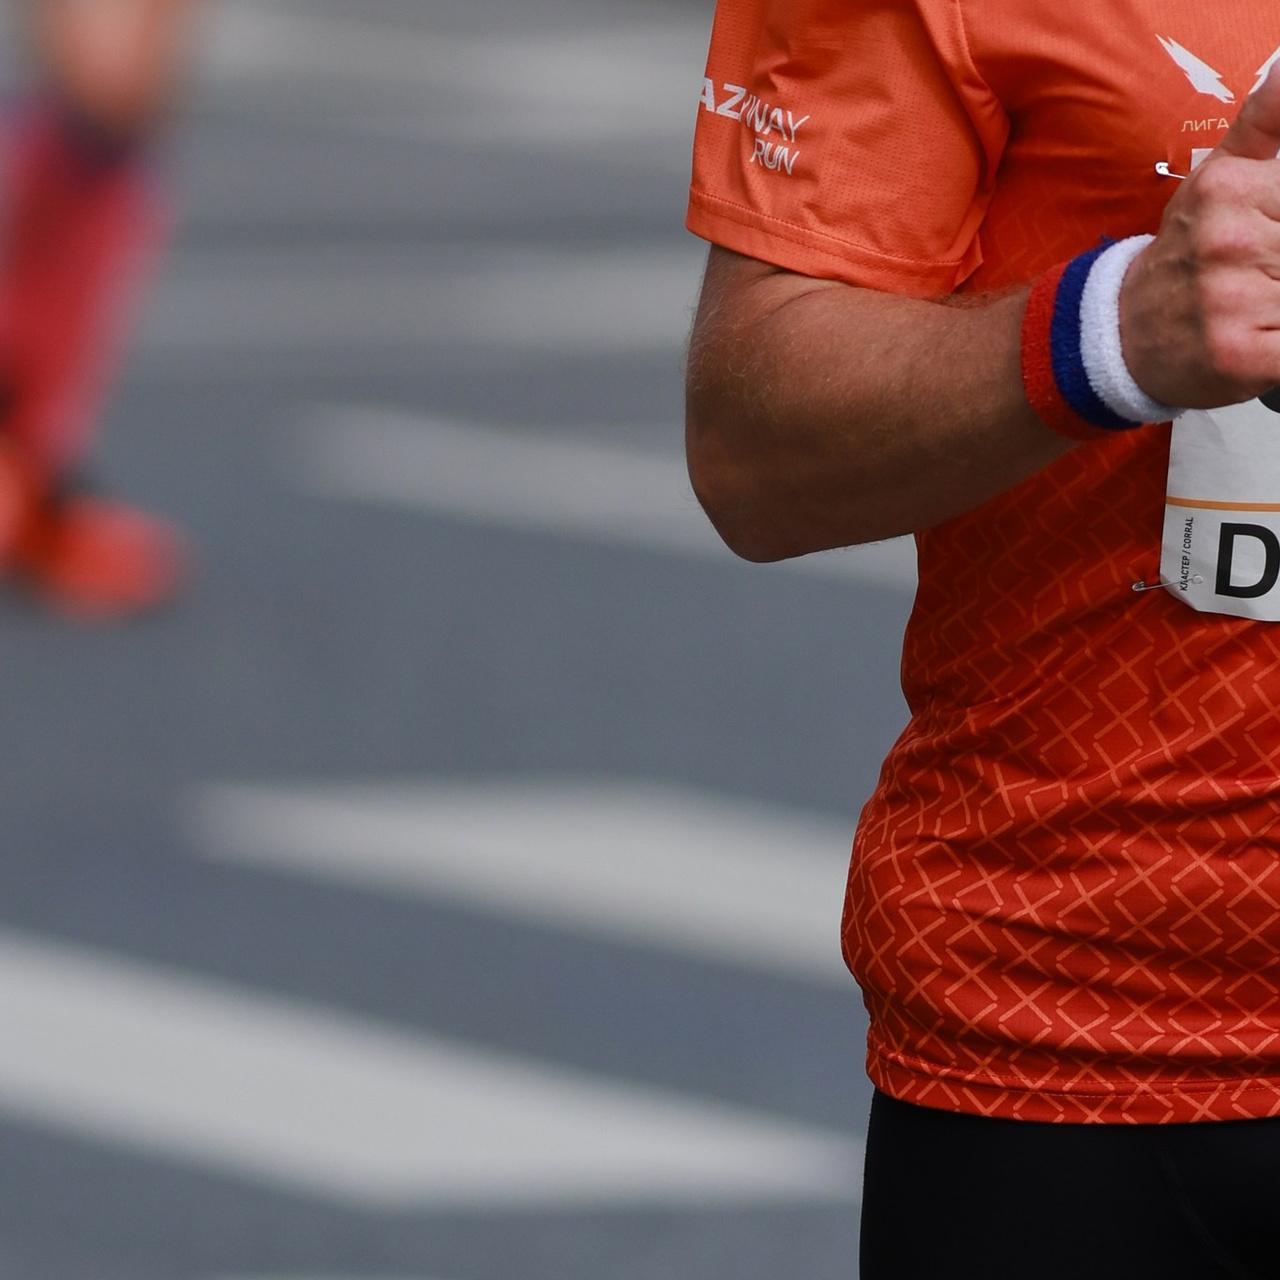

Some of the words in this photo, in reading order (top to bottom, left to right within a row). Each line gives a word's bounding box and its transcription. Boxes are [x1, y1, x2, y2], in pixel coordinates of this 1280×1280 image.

[1181, 118, 1229, 132] ЛИГА
[750, 138, 800, 175] RUN
[1183, 517, 1194, 552] CORRAL
[1215, 522, 1280, 599] D
